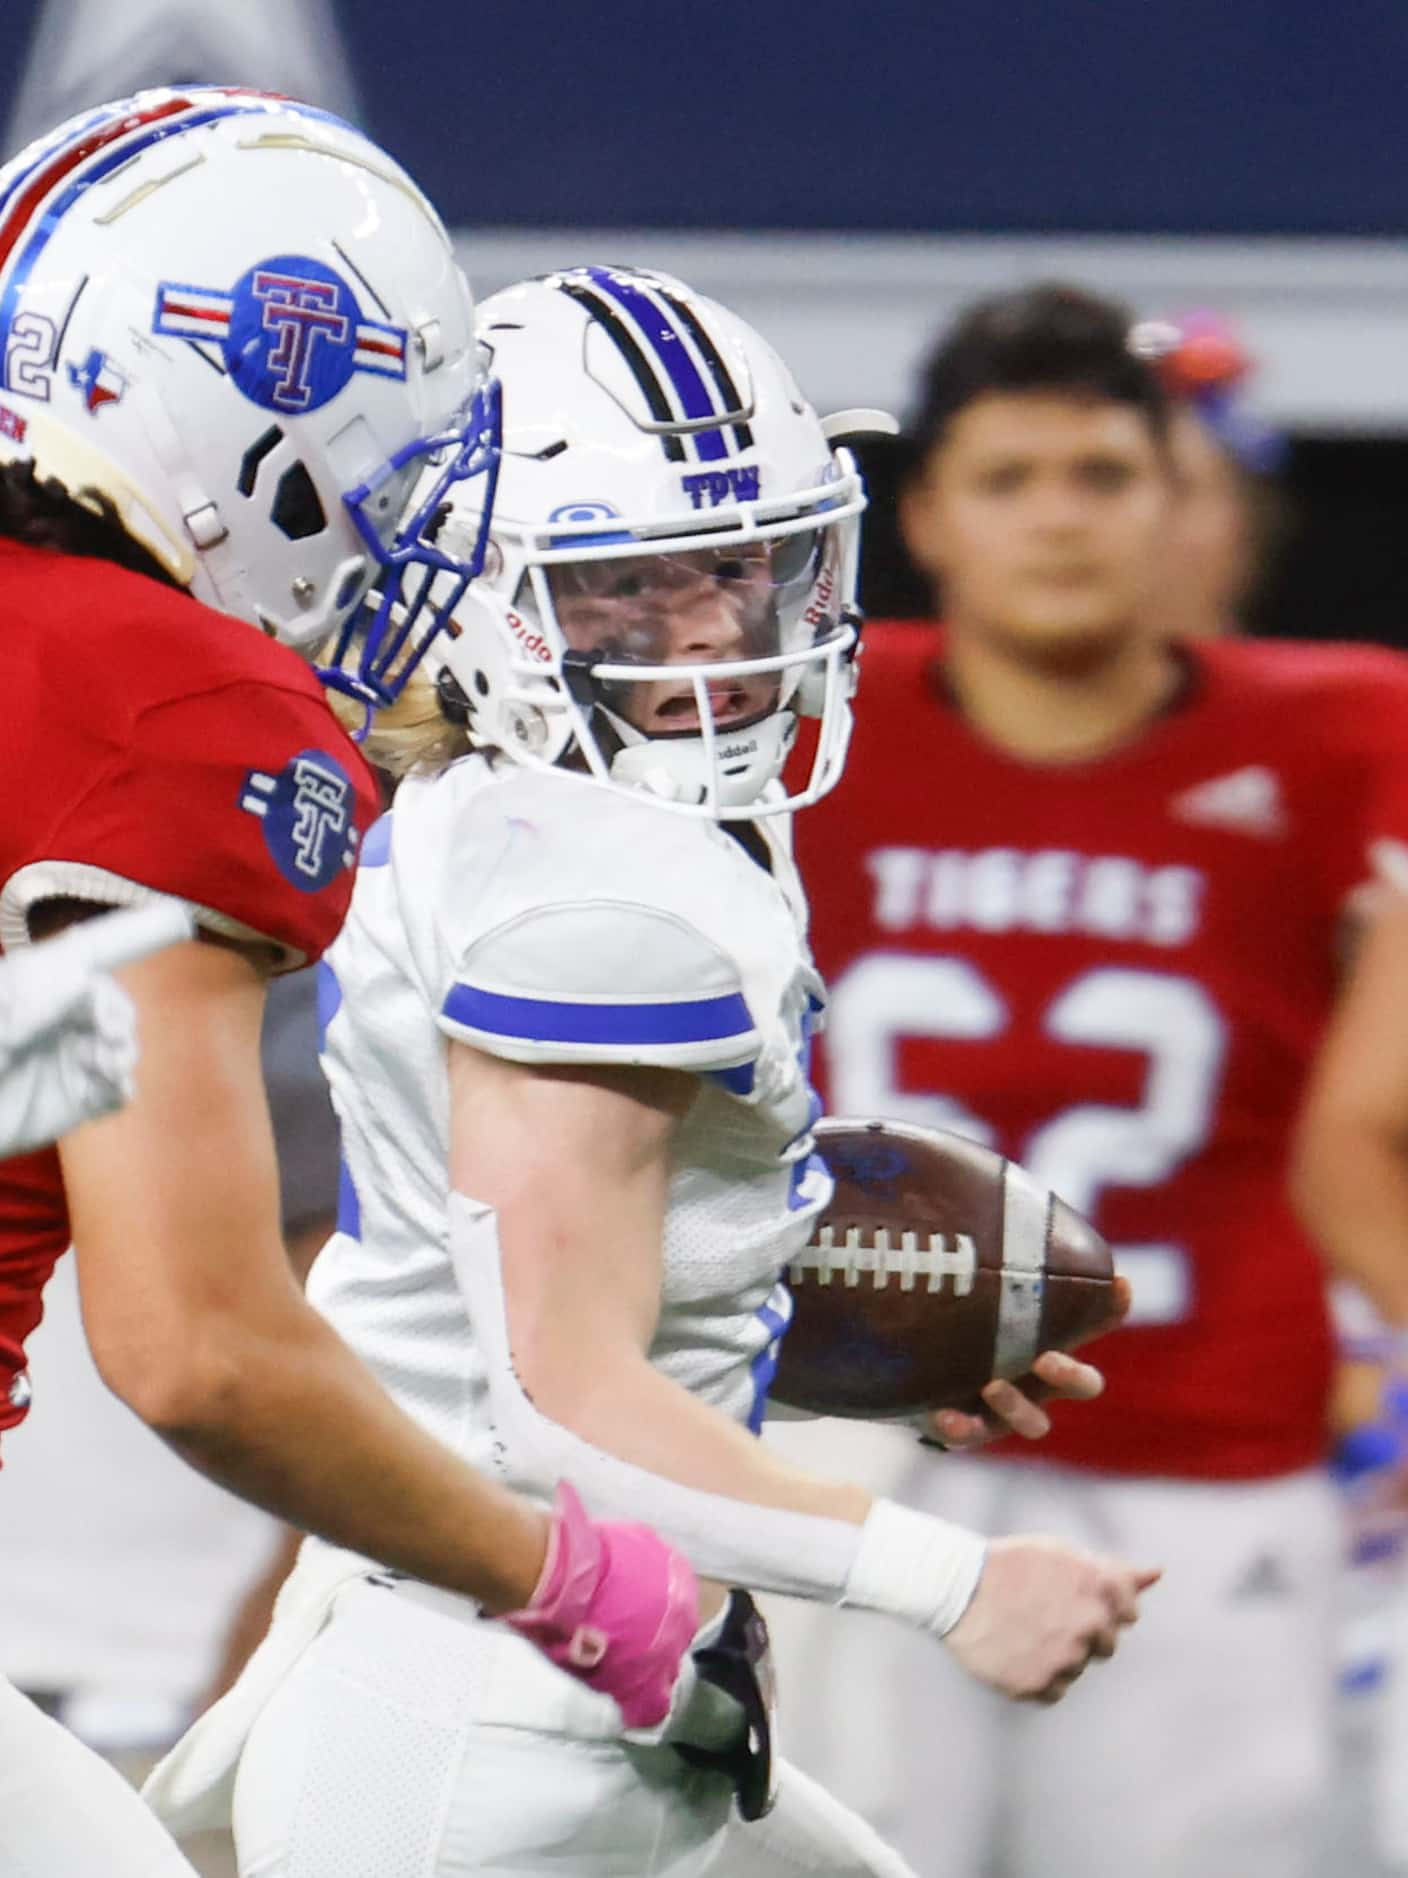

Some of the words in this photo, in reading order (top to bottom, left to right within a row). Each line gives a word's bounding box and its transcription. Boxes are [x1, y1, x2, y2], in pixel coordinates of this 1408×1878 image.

[7, 311, 58, 402] 2
[681, 464, 760, 510] TPW
[867, 845, 1206, 947] TIGERS
